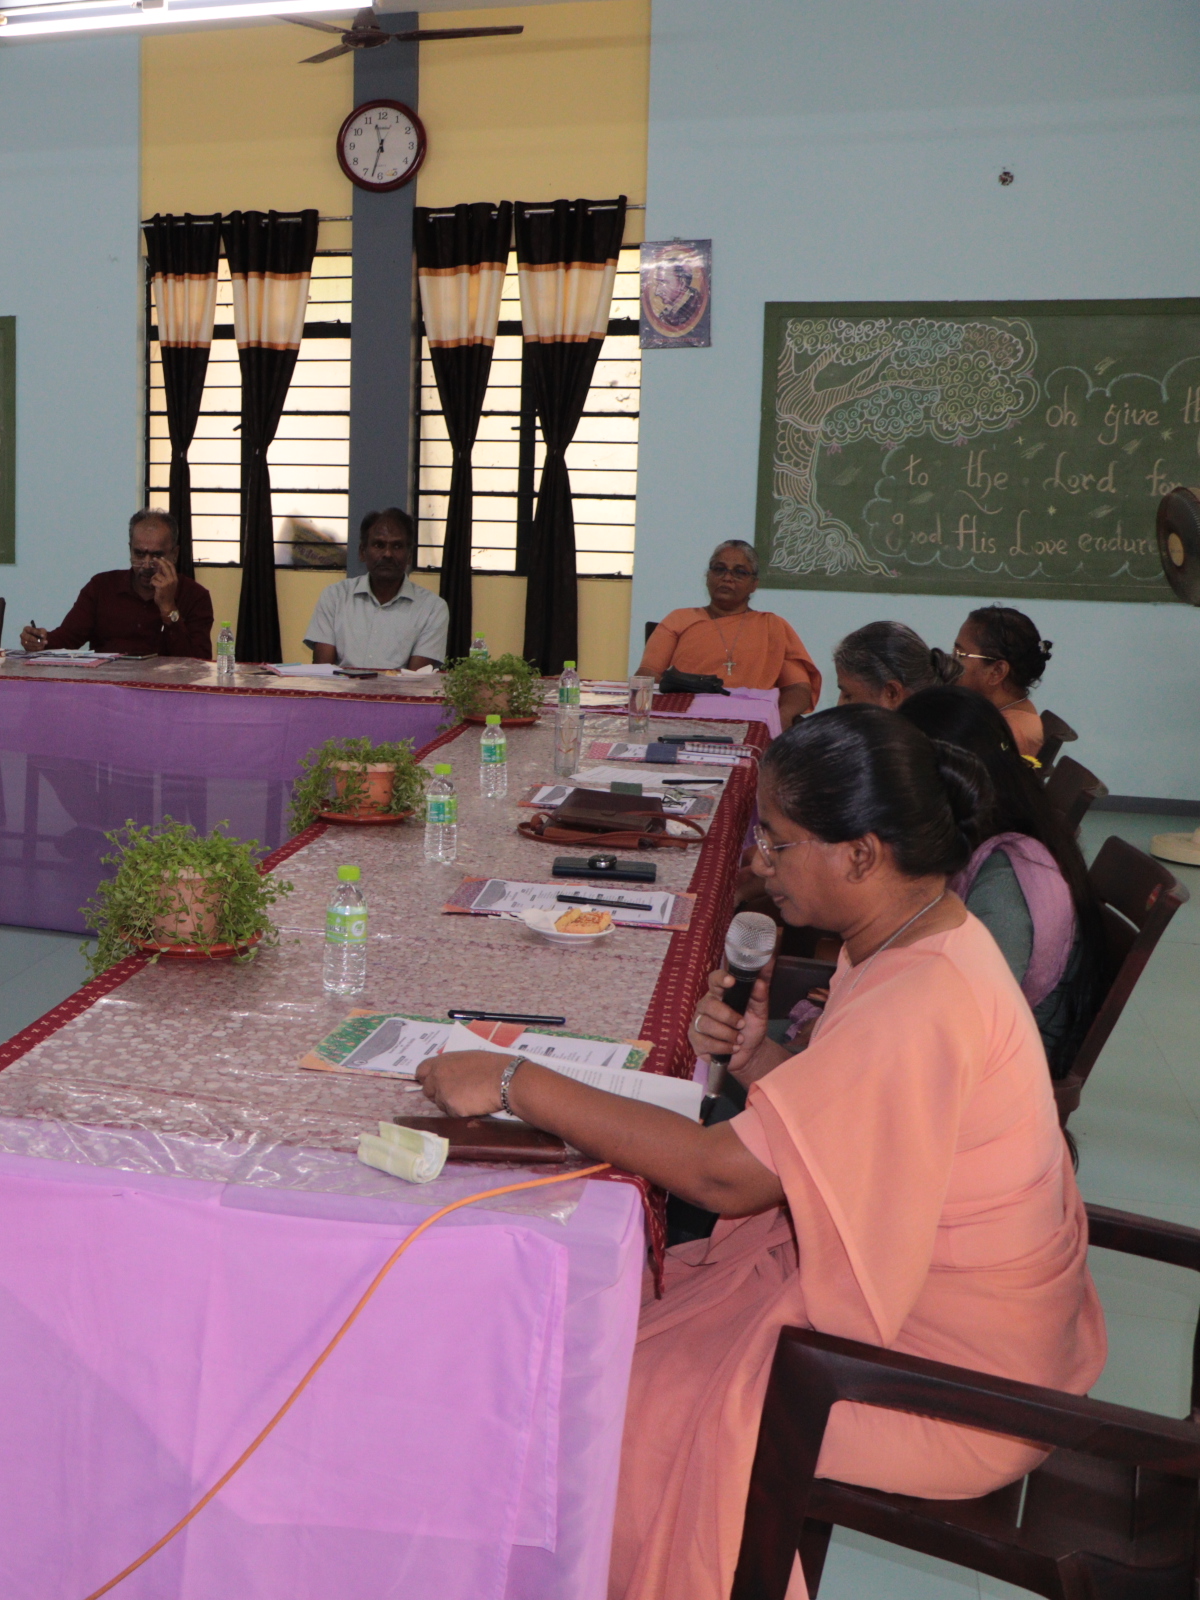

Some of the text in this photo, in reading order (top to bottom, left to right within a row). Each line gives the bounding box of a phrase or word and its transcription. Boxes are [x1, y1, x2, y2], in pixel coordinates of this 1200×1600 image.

[1097, 402, 1160, 445] give
[902, 454, 929, 485] to
[961, 449, 1008, 499] the
[1043, 451, 1118, 495] Lord
[952, 514, 996, 553] His
[1009, 510, 1068, 556] Love
